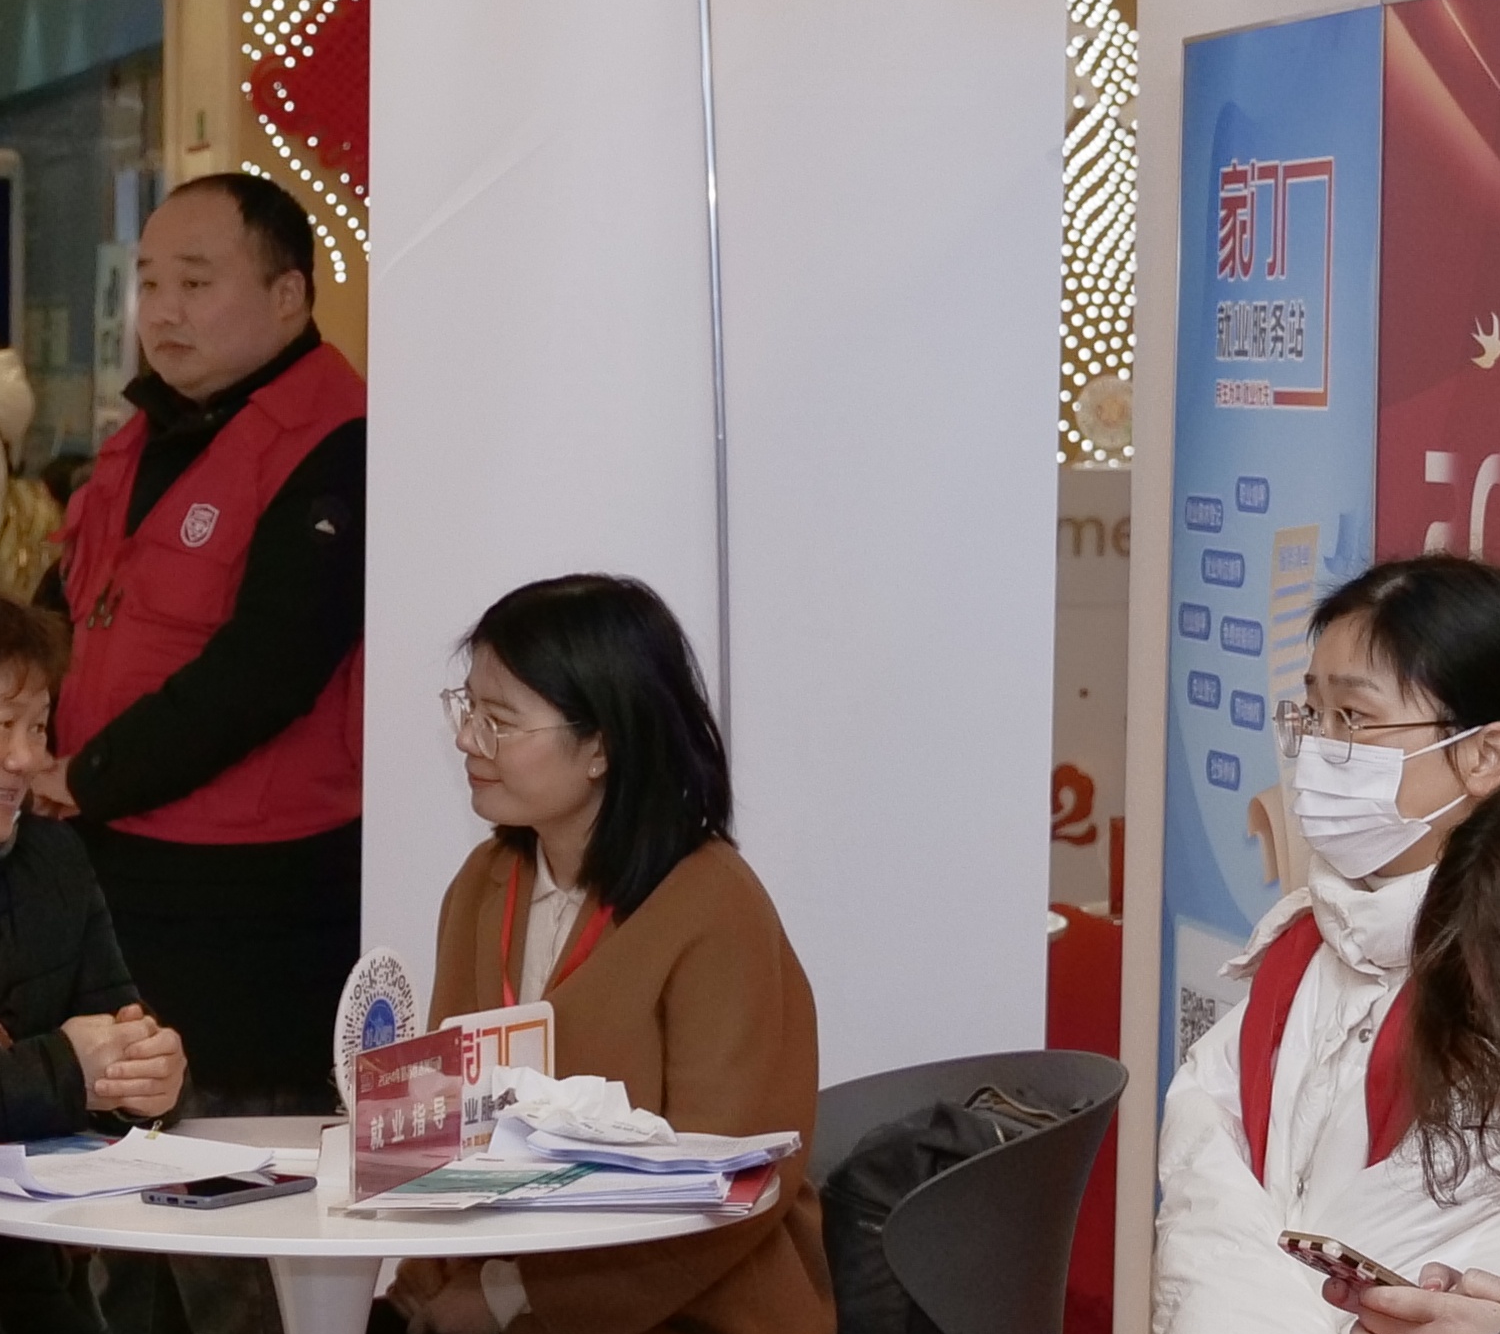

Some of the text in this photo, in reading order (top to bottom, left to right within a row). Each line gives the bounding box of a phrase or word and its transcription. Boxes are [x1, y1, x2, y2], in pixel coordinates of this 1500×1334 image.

[1215, 299, 1305, 362] 就业服务站
[369, 1095, 447, 1152] 就业指导
